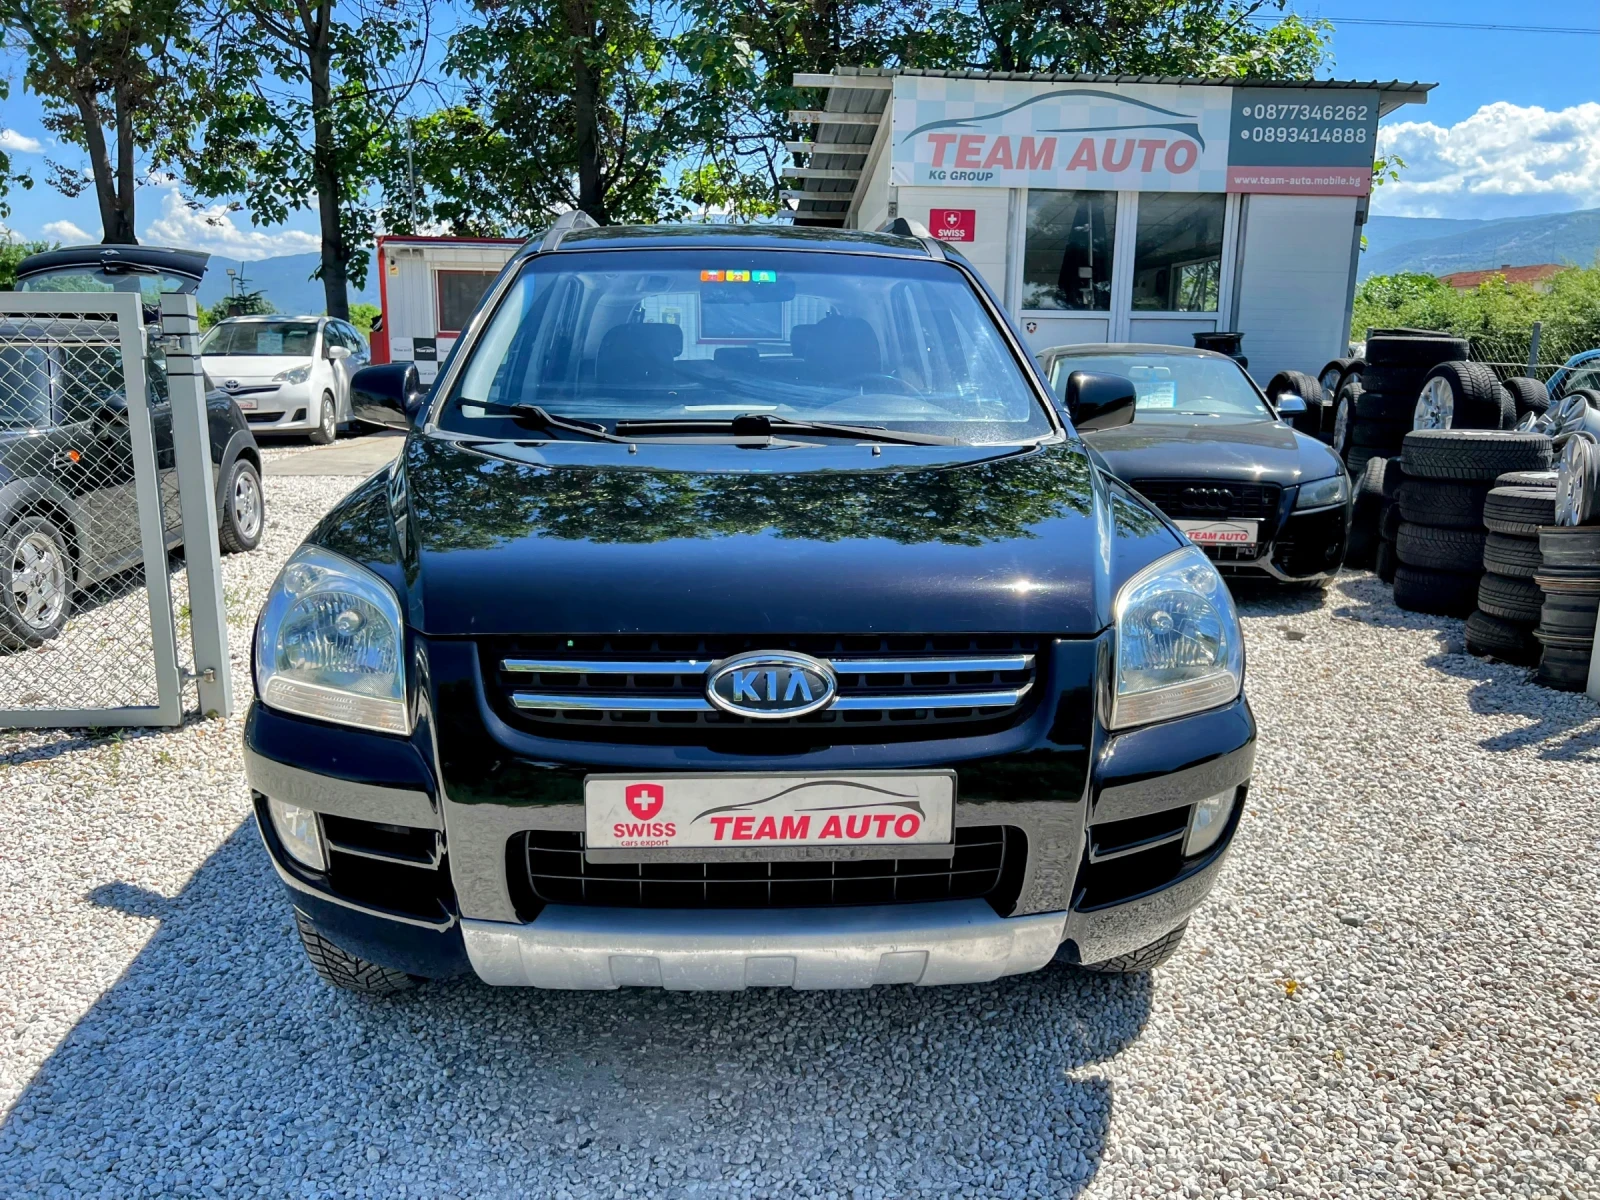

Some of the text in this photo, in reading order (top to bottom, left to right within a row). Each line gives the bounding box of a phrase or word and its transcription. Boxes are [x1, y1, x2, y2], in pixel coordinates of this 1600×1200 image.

[1253, 103, 1369, 121] 0877346262
[1251, 126, 1367, 143] 0893414888
[927, 133, 1199, 175] TEAM AUTO
[928, 170, 994, 182] KG GROUP
[1233, 175, 1361, 187] www.team-auto.mobile.bg
[937, 228, 965, 237] SWISS
[1188, 532, 1248, 541] TEAM AUTO
[732, 670, 814, 702] KIA
[613, 822, 677, 838] SWISS
[709, 813, 921, 841] TEAM AUTO
[640, 839, 669, 848] export
